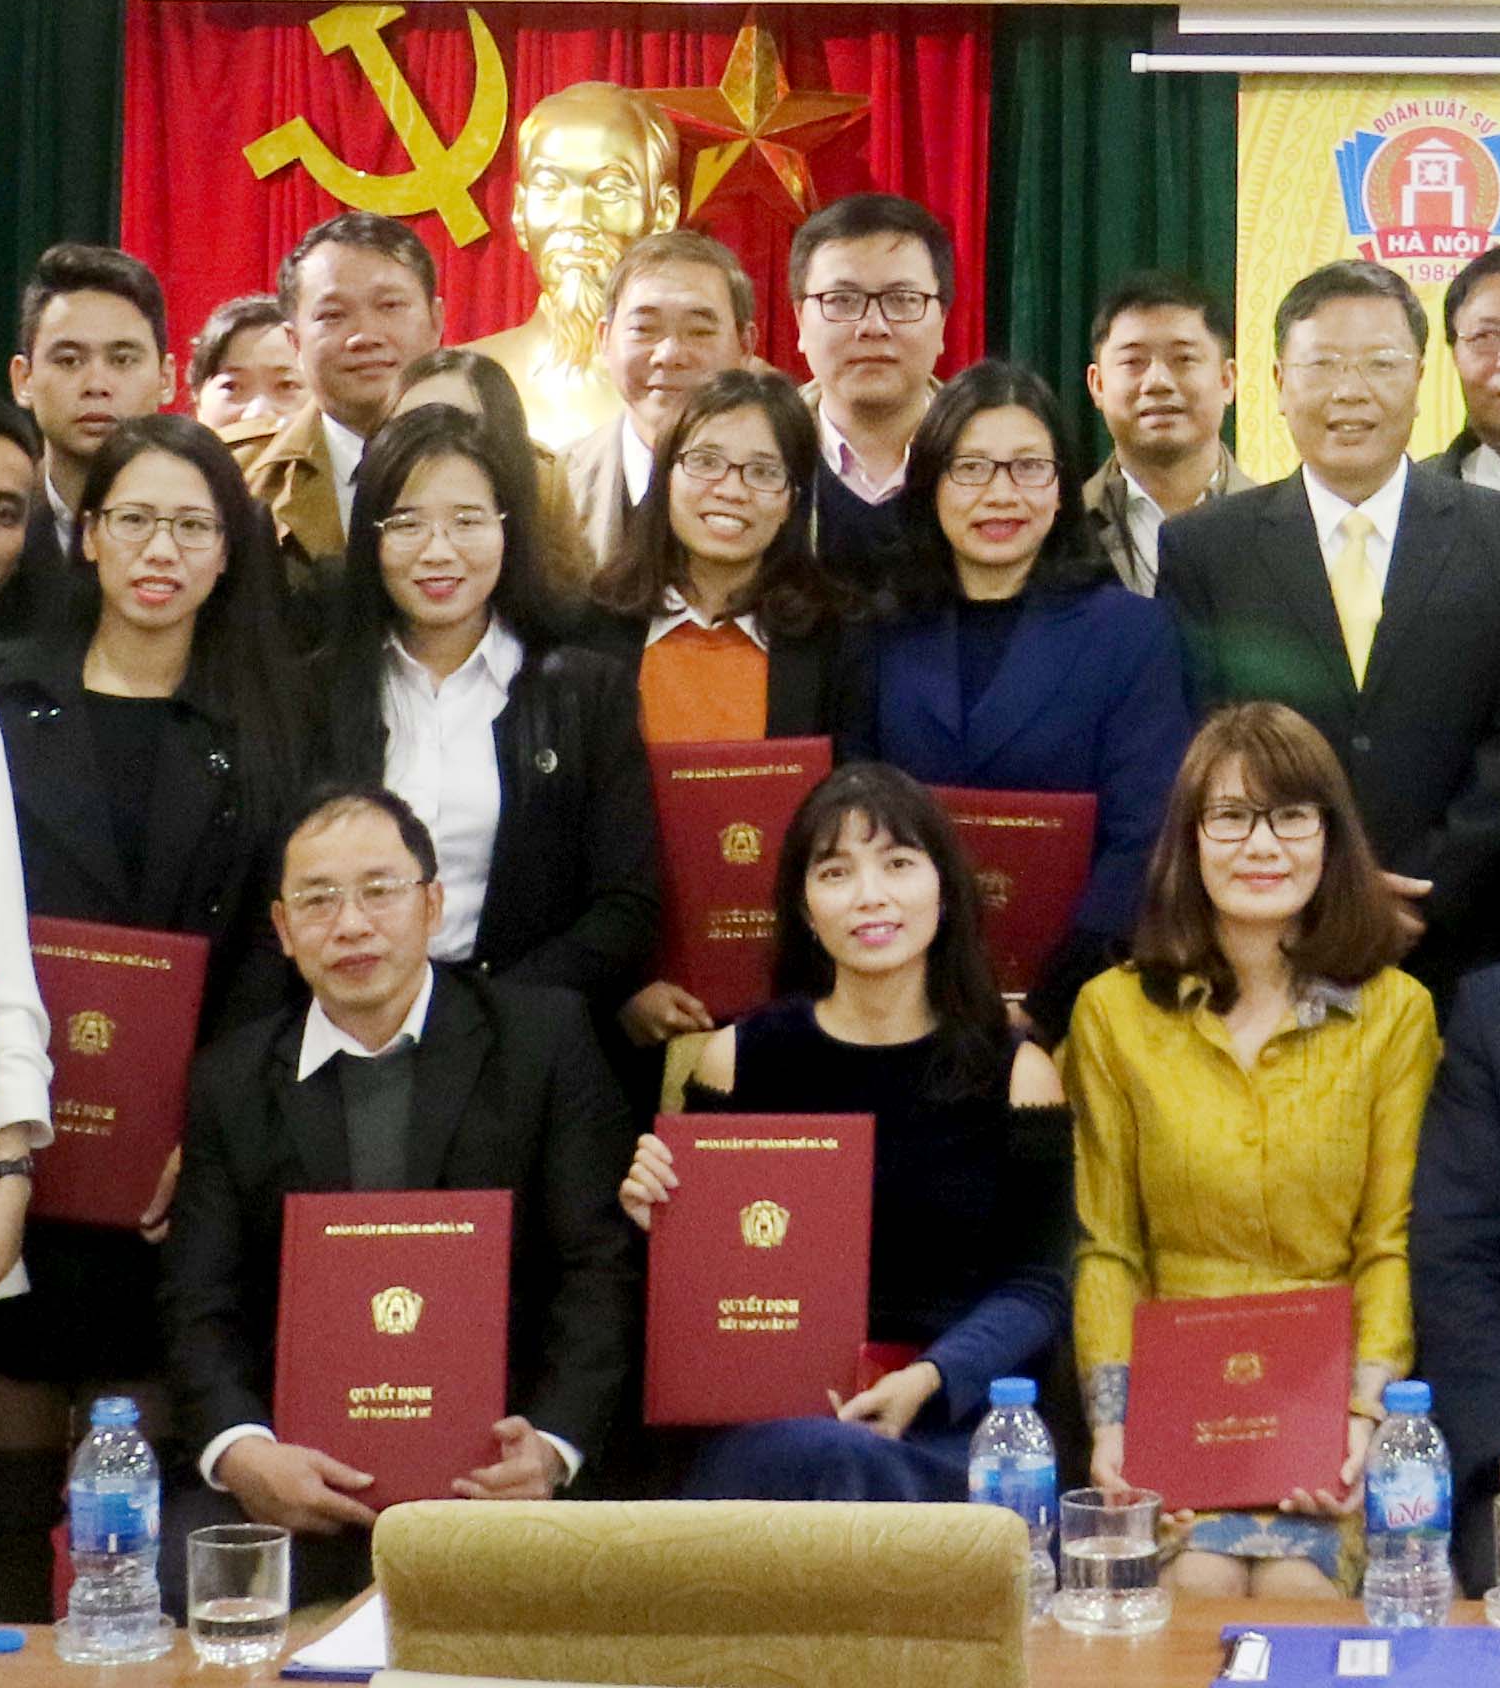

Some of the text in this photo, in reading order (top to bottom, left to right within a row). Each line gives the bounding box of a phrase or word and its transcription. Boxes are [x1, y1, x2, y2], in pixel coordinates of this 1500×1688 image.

[1470, 111, 1499, 134] SƯ
[1387, 230, 1480, 259] HÀ NỘI
